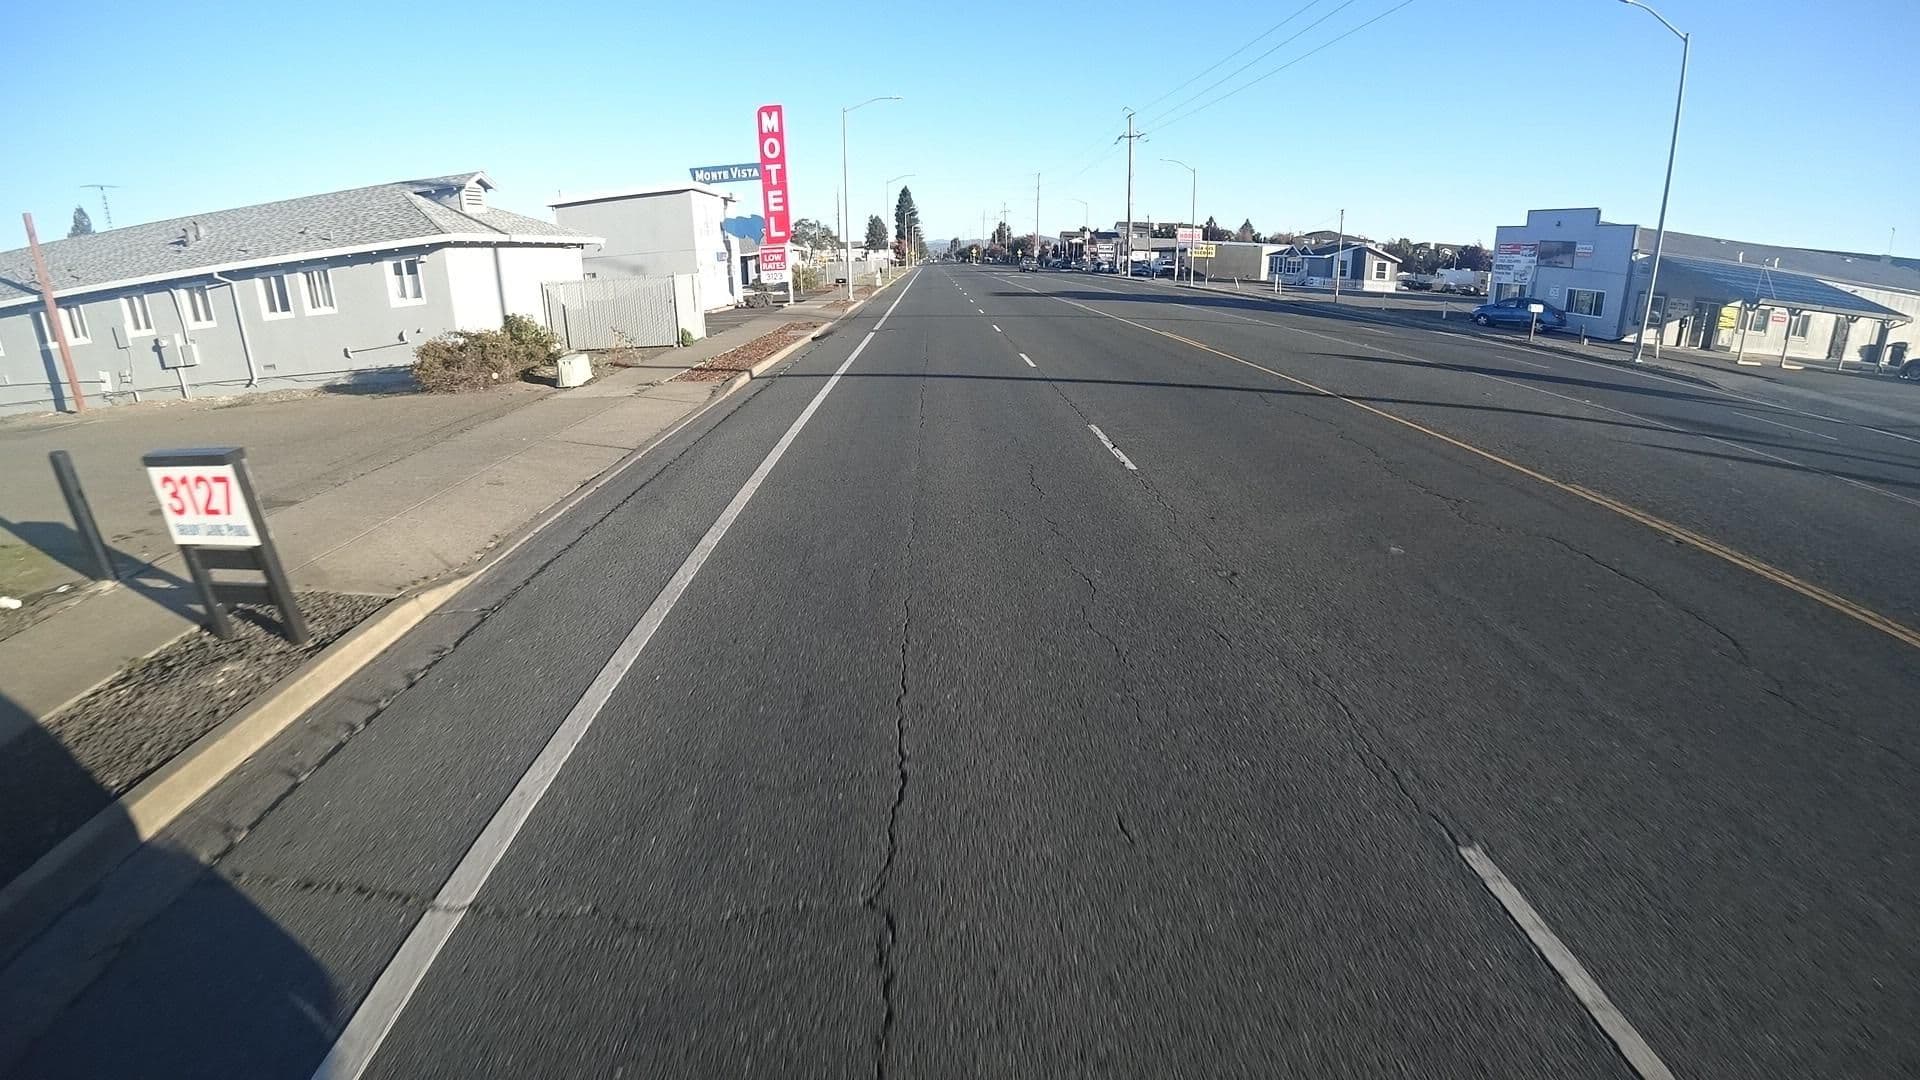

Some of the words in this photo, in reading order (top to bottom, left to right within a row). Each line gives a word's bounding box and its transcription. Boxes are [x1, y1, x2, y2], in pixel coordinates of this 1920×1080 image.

[695, 169, 729, 182] MONTE
[729, 167, 760, 179] VISTA
[761, 111, 786, 238] MOTEL
[763, 262, 785, 270] RATES
[161, 475, 231, 516] 3127
